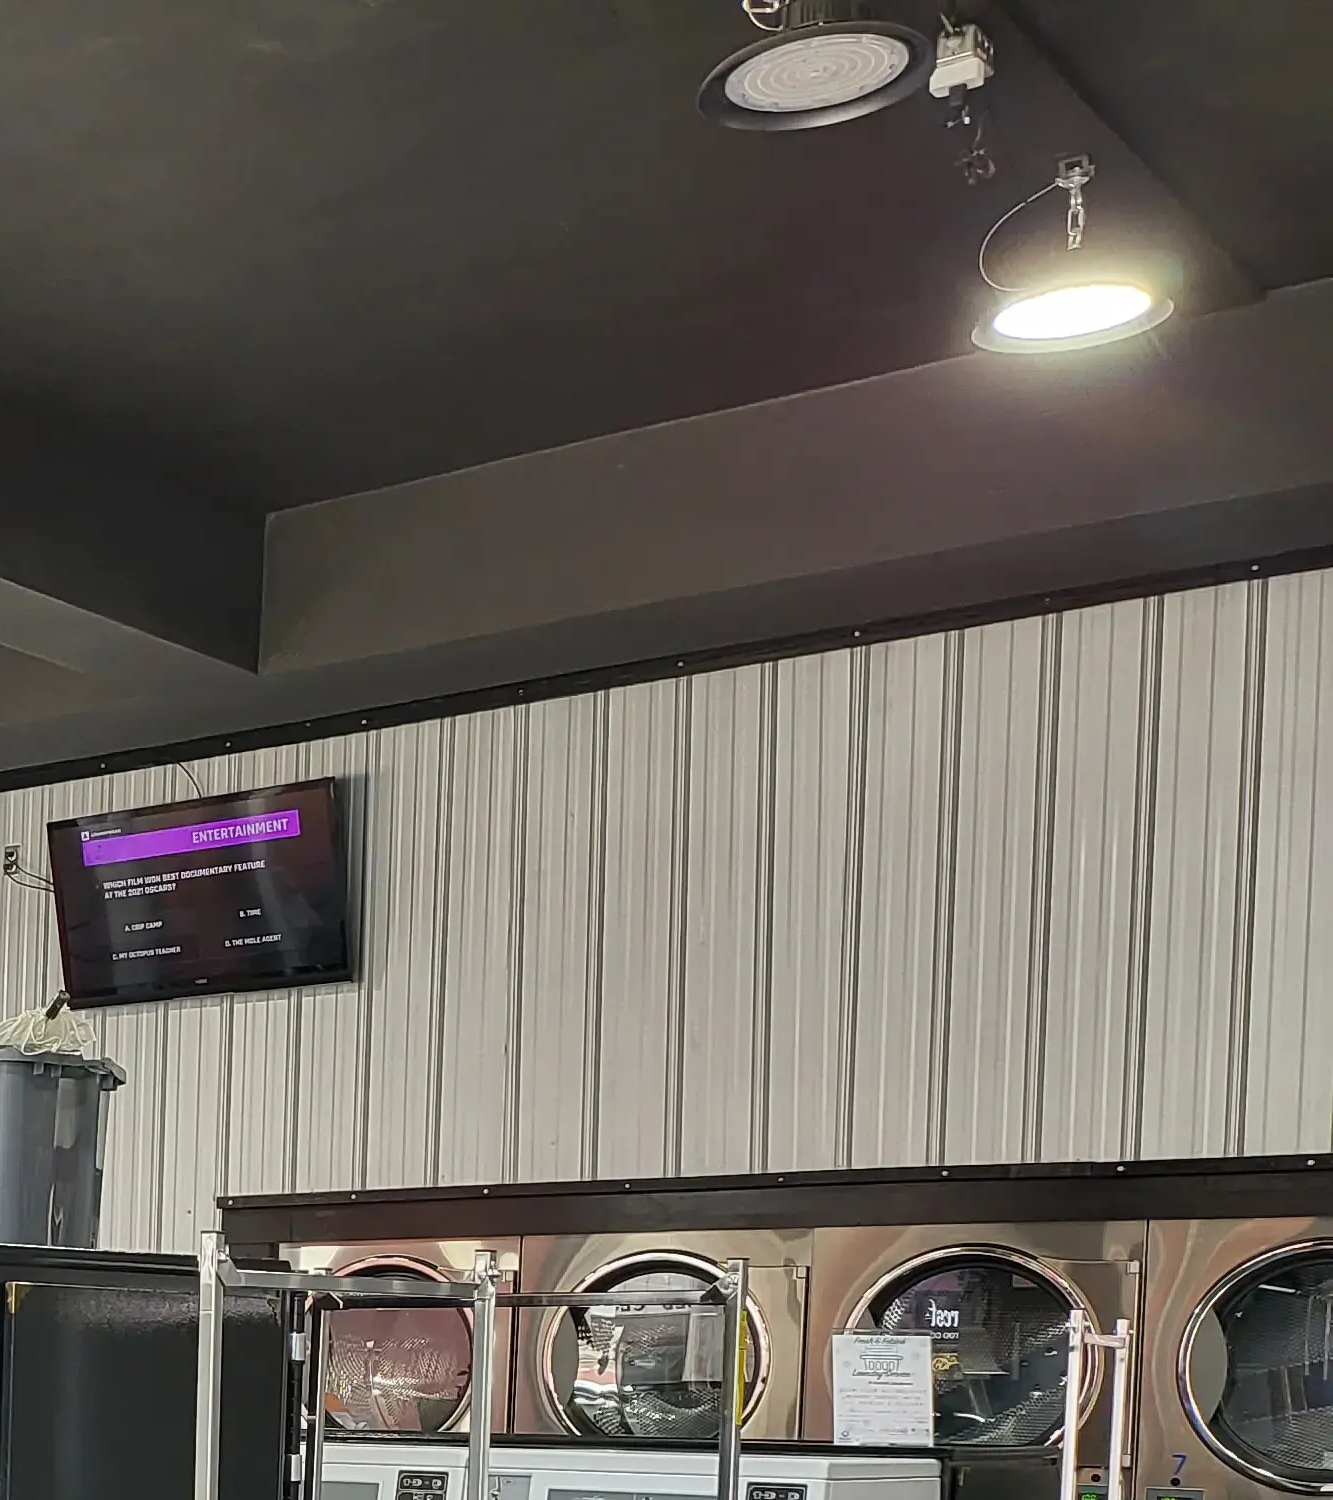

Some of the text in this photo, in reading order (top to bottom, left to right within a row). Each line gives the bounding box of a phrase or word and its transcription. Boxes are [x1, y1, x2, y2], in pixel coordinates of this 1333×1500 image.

[192, 818, 289, 844] ENTERTAINMENT
[103, 860, 266, 890] WHICH FILM WON BEST DOCUMENTARY FEATURE
[104, 882, 176, 899] AT THE 2021 OSCARS?
[1171, 1454, 1187, 1475] 7
